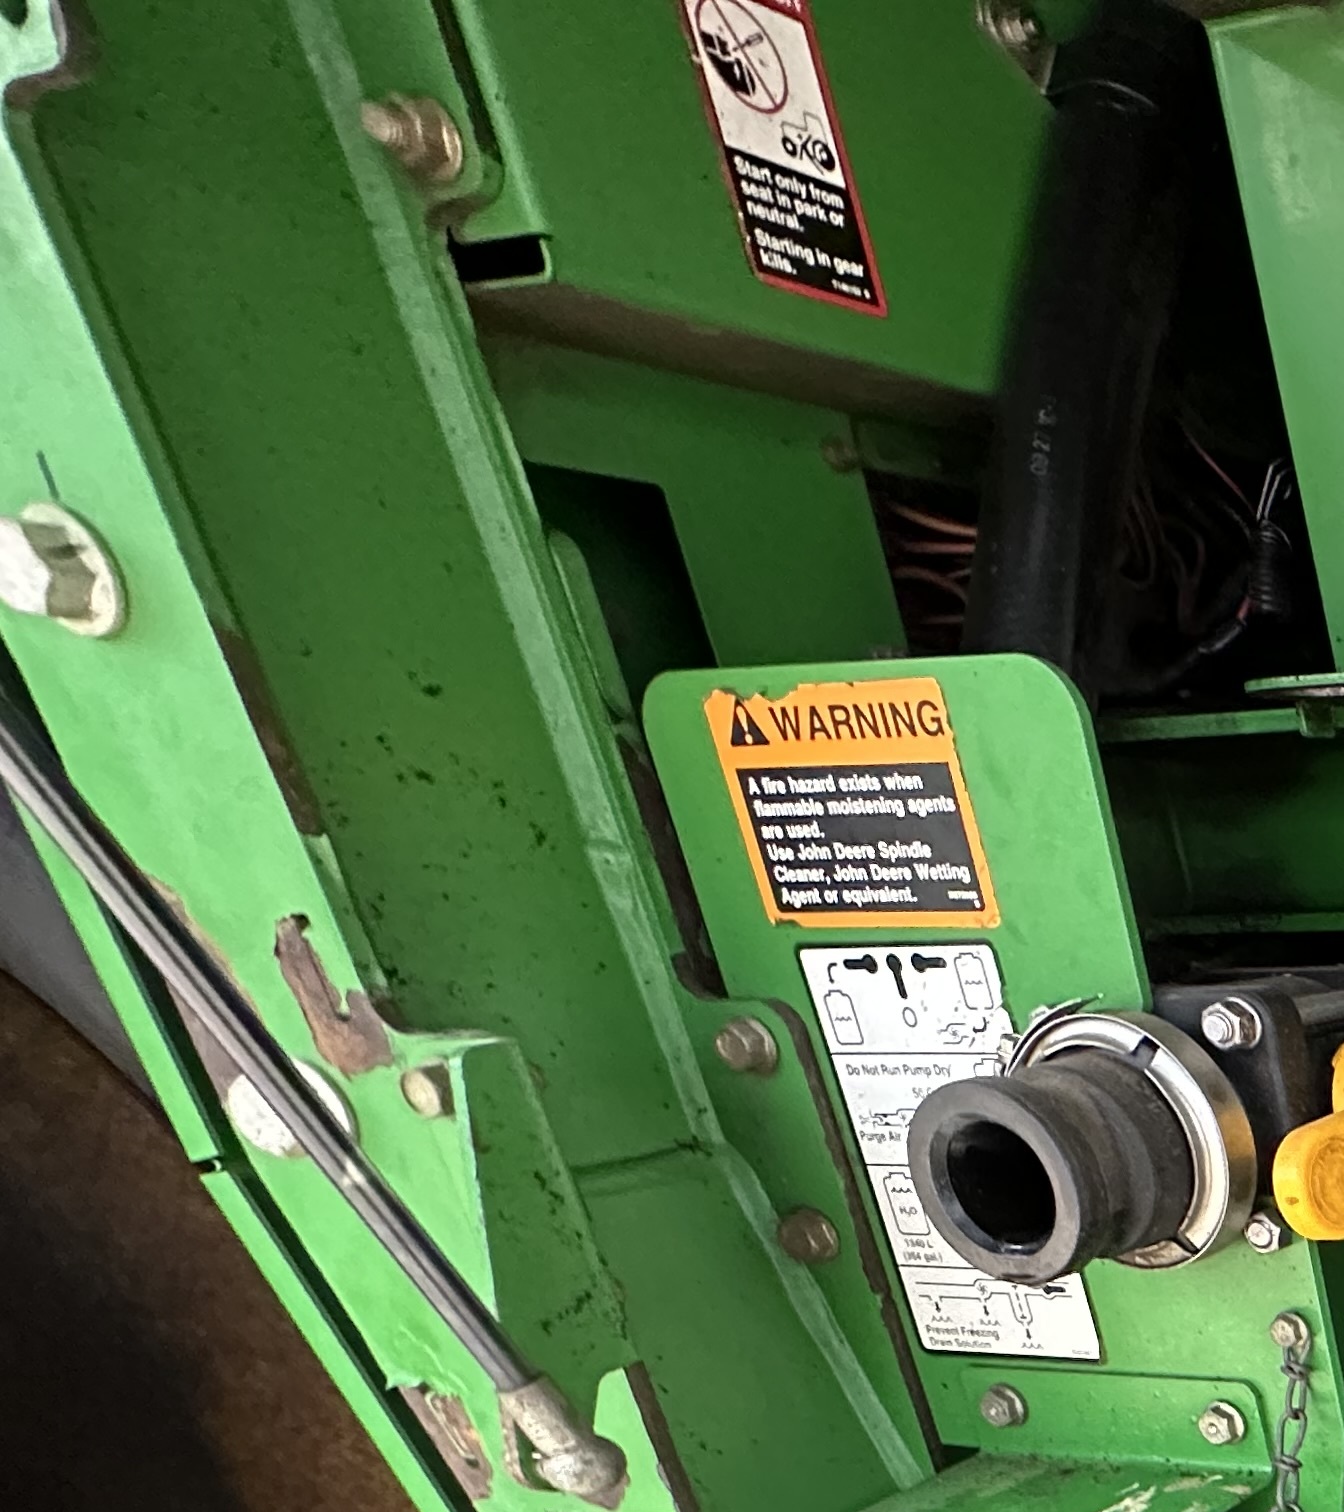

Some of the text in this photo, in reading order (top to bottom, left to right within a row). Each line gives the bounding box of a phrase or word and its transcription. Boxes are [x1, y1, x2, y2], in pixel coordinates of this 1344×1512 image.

[733, 155, 845, 210] Start only from
[741, 180, 844, 228] seat in park or
[746, 200, 805, 233] neutral.
[754, 227, 864, 277] Starting in gear
[759, 248, 797, 275] kills.
[768, 700, 945, 741] WARNING
[748, 772, 923, 796] A fire hazard exists when
[753, 795, 956, 818] flammable moistening agents
[761, 821, 825, 839] are used.
[766, 840, 932, 863] Use John Deere Spindle
[773, 863, 971, 885] Cleaner, John Deere Wetting
[781, 886, 918, 908] Agent or equivalent.
[846, 1064, 951, 1079] Do Not Run Pump Dry
[860, 1130, 886, 1144] Purge
[960, 1326, 1000, 1341] Freezing
